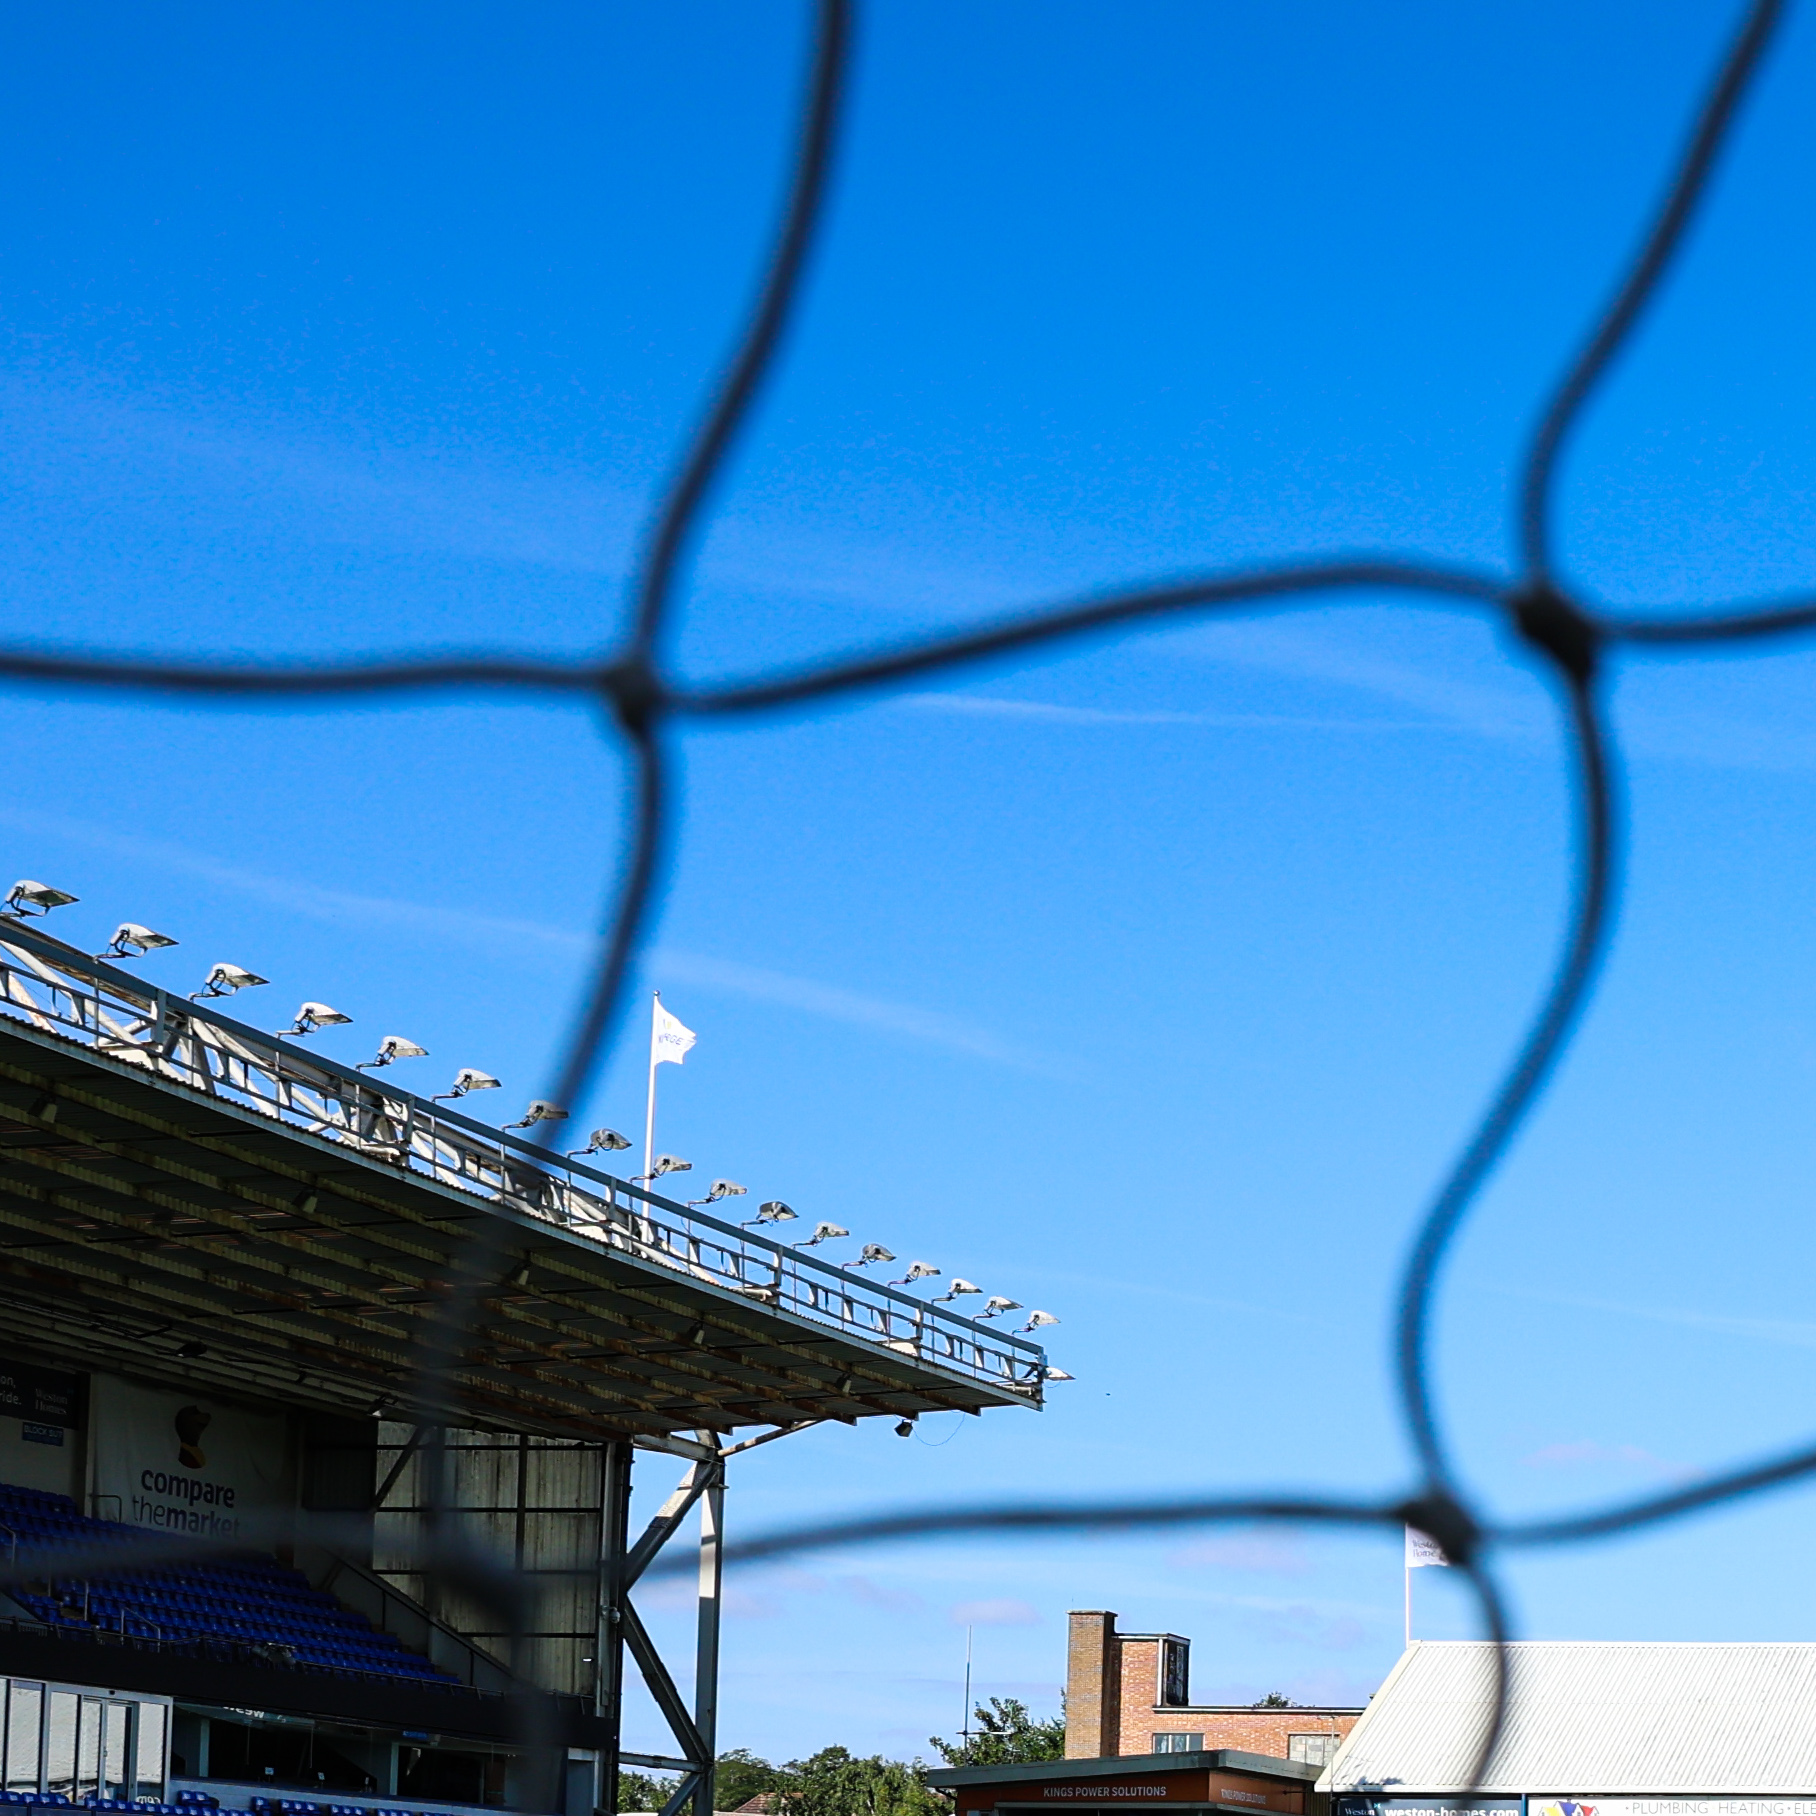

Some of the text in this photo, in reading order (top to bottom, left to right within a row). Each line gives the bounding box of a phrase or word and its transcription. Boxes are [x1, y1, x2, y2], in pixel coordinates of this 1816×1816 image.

[141, 1469, 235, 1508] compare
[1044, 1786, 1166, 1798] KINGS POWER SOLUTIONS
[1345, 1807, 1375, 1816] Weston
[1632, 1802, 1709, 1815] PLUMBING
[1719, 1802, 1785, 1815] HEATING
